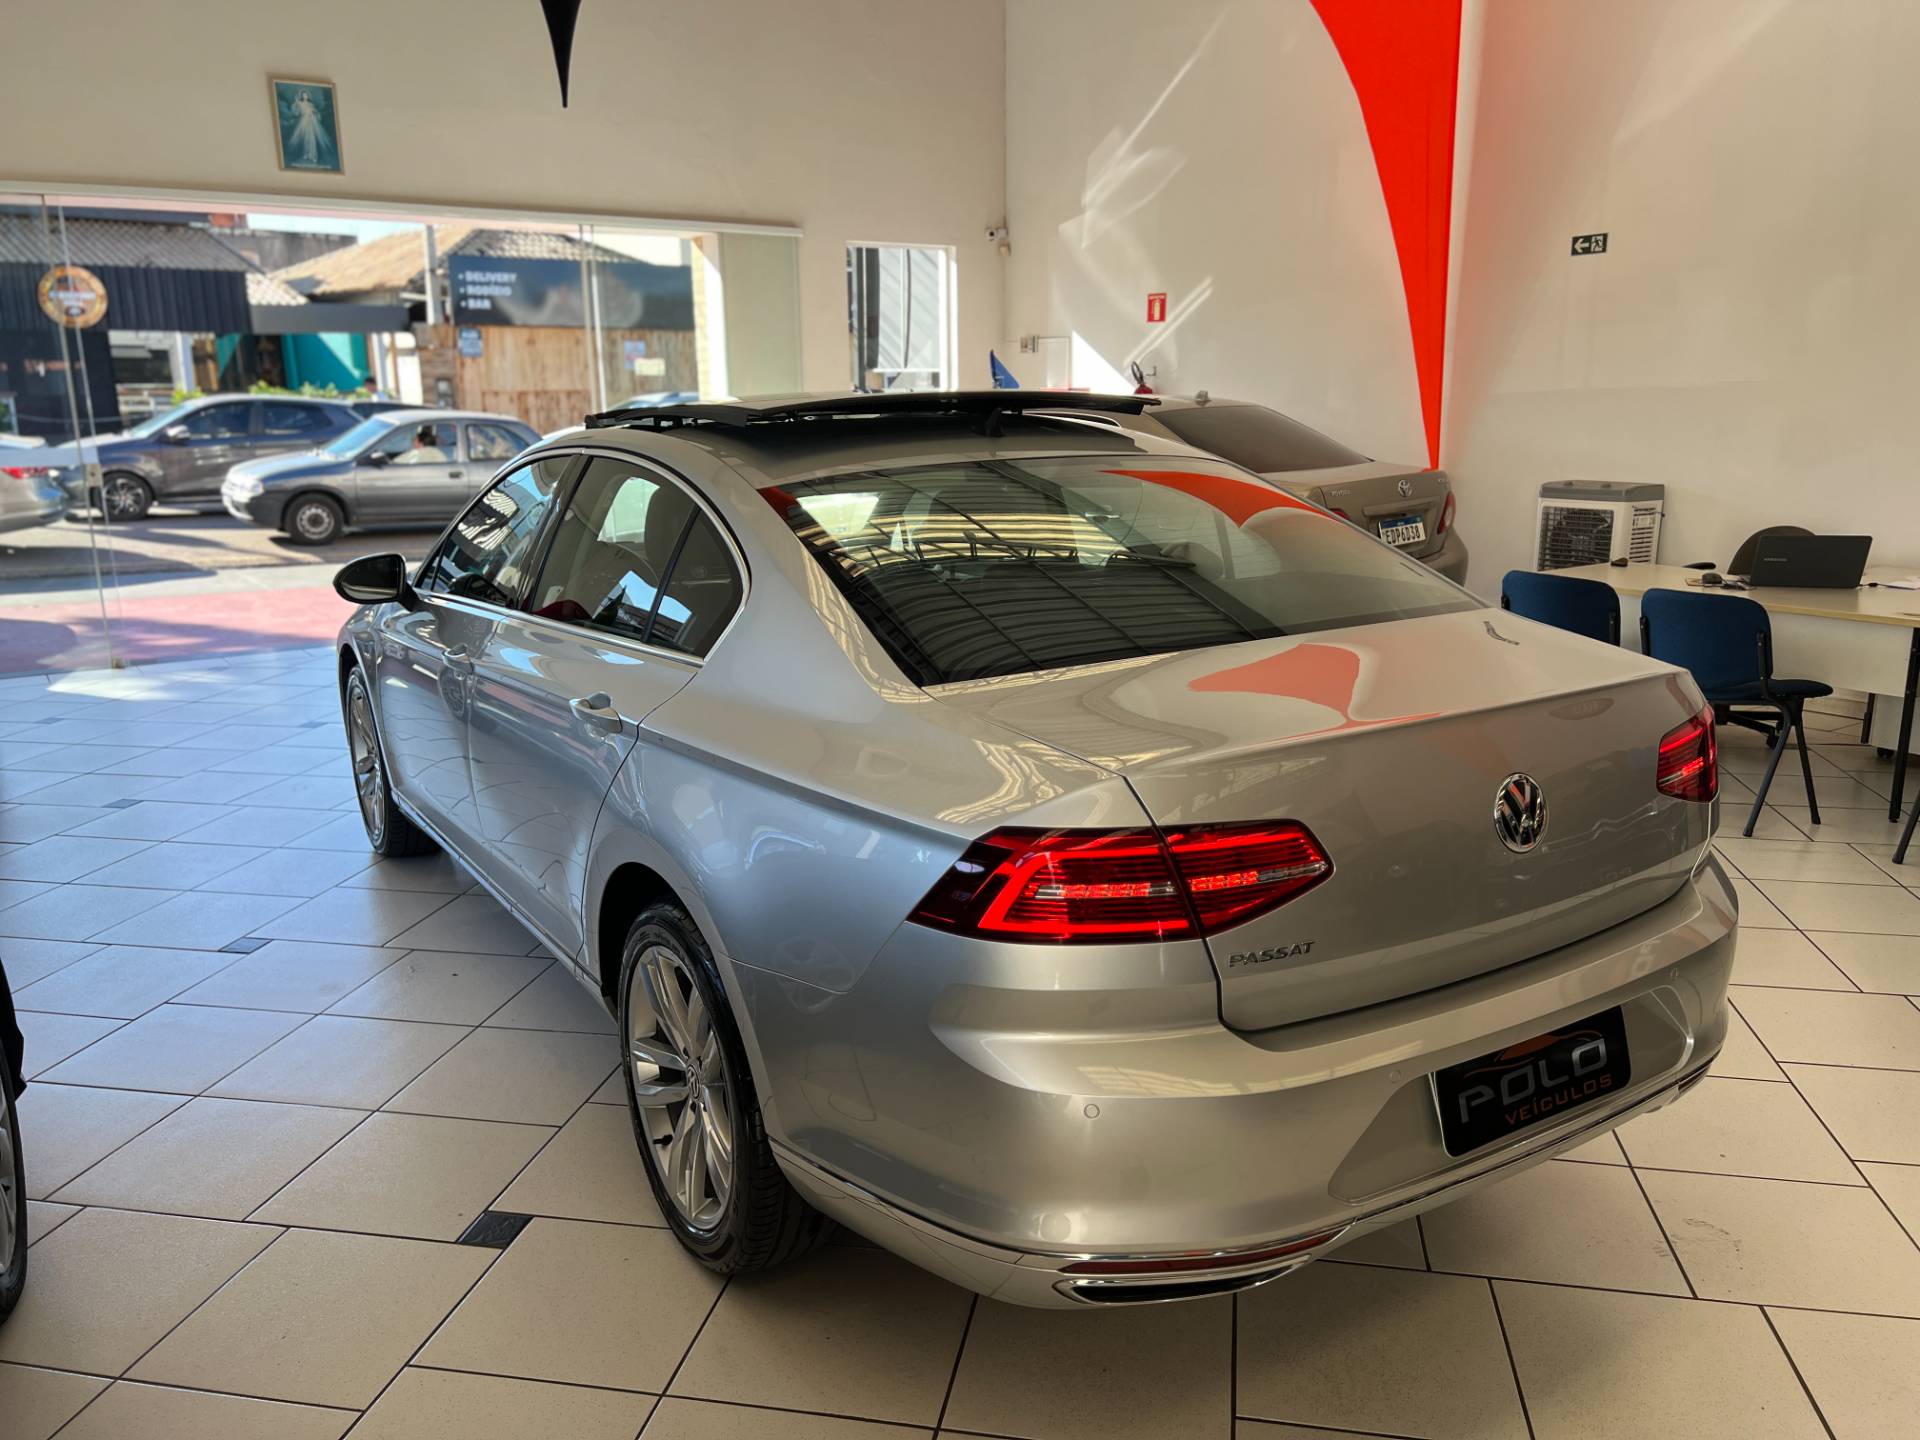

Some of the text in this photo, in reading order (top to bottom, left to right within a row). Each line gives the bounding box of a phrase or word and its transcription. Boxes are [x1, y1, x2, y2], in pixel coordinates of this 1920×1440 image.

[465, 271, 518, 283] DELIVERY
[467, 298, 492, 310] BAR
[1385, 524, 1421, 545] EDP6D38
[1229, 941, 1316, 968] PASSAT
[1458, 1037, 1608, 1124] POLO
[1505, 1073, 1613, 1126] VEÍCULOS
